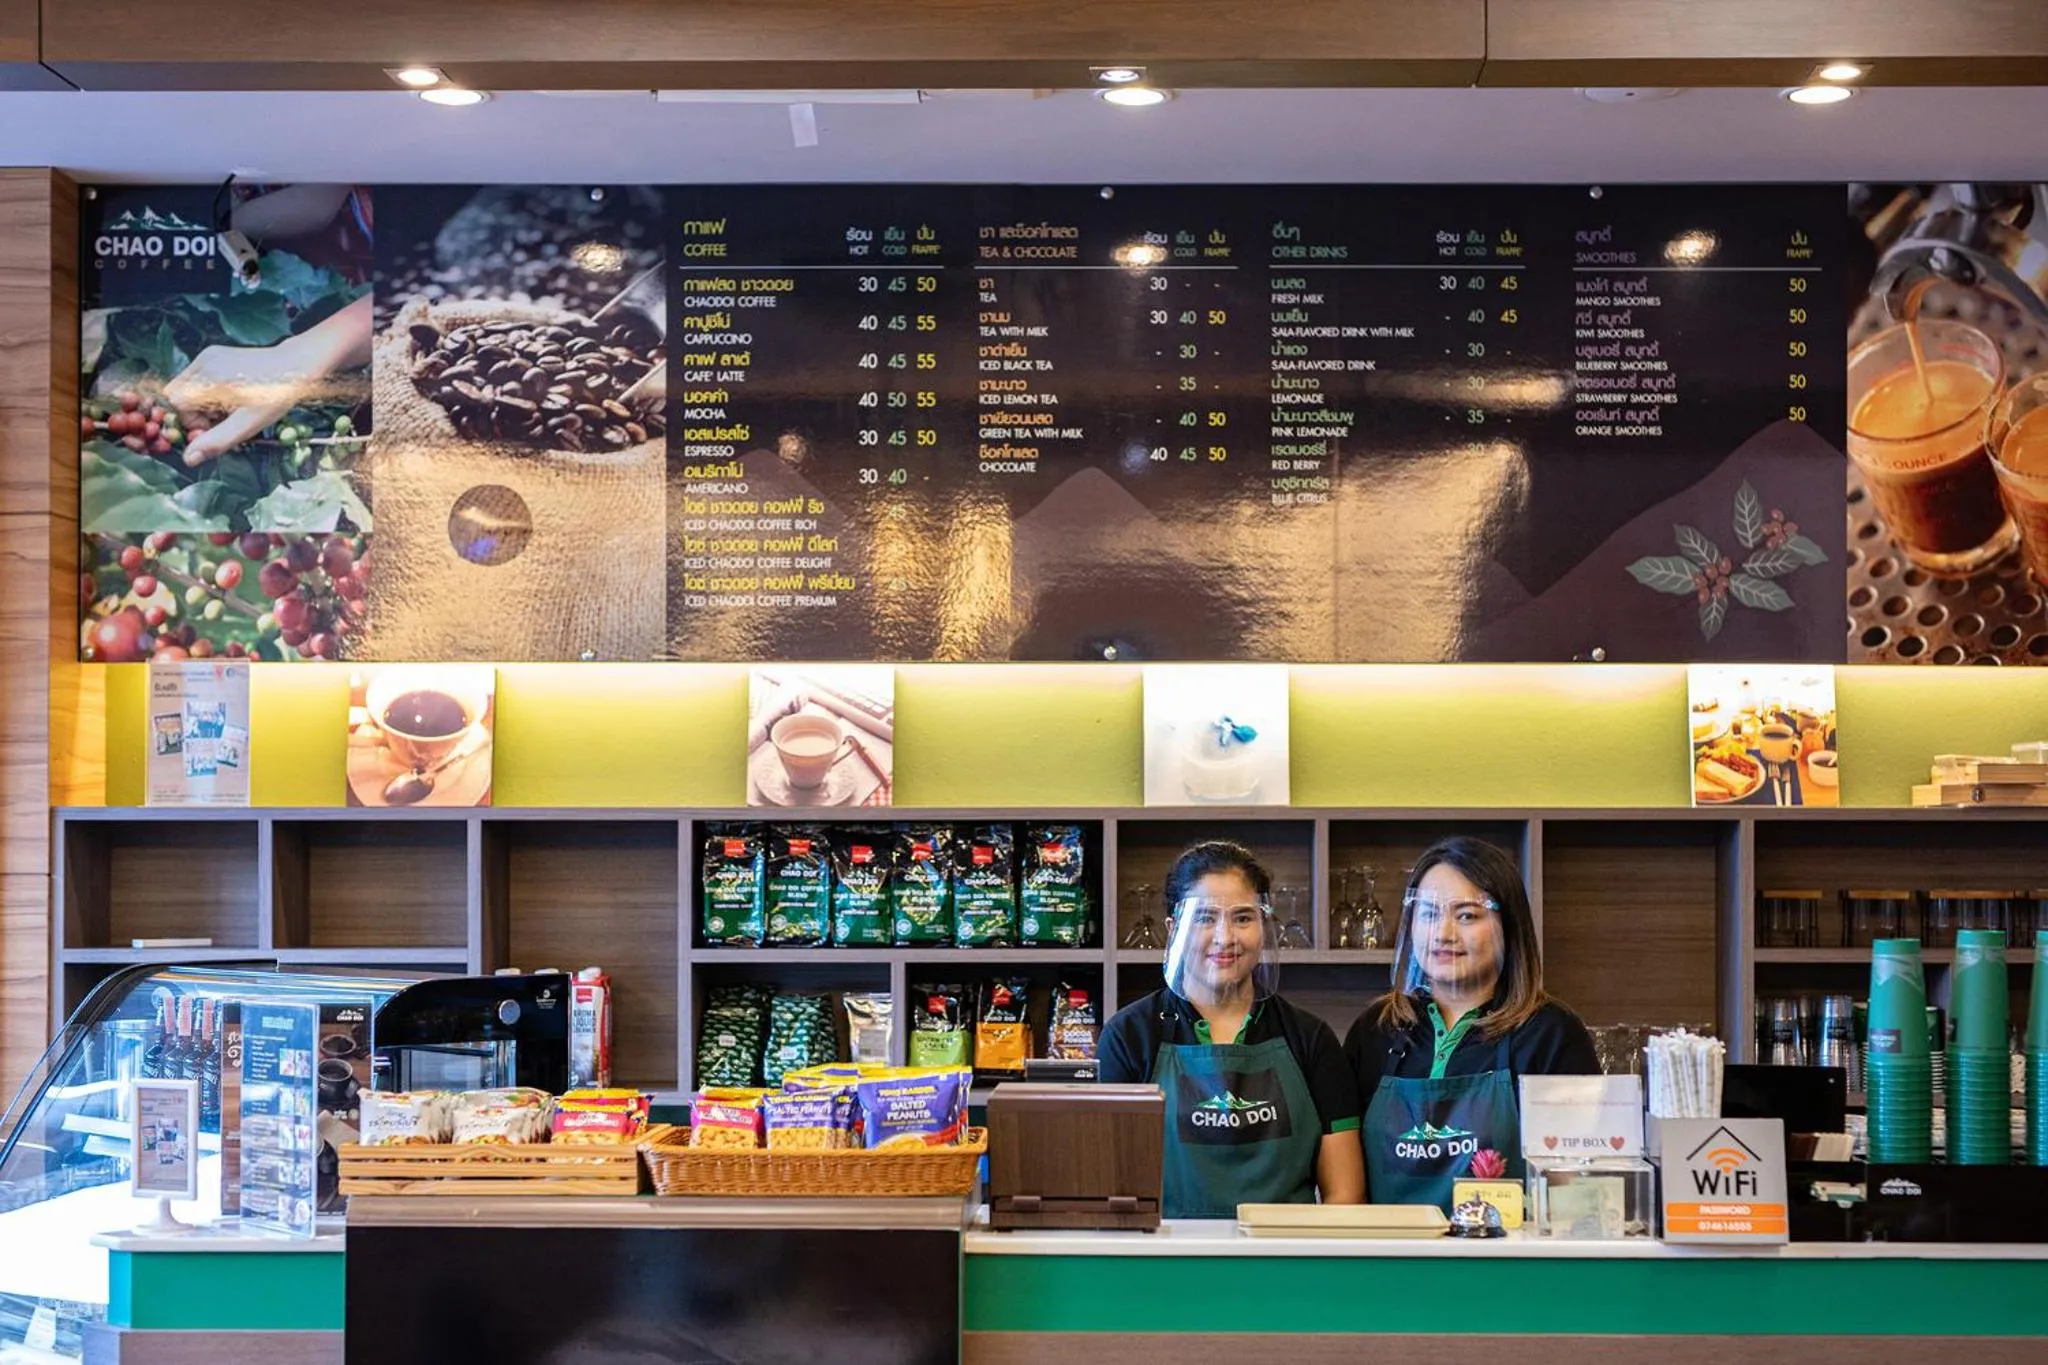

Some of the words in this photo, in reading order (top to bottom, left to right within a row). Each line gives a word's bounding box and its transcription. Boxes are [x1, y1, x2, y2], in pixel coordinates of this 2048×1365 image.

[684, 219, 727, 236] กาแฟ
[980, 227, 995, 239] ชา
[95, 236, 163, 256] CHAO
[173, 236, 215, 256] DOI
[684, 244, 727, 257] COFFEE
[849, 244, 869, 256] HOT
[882, 244, 907, 256] COLD
[979, 246, 998, 258] TEA
[1003, 246, 1011, 258] &
[1014, 246, 1078, 258] CHOCOLATE
[1272, 246, 1307, 258] OTHER
[1310, 246, 1348, 258] DRINKS
[1439, 246, 1457, 256] HOT
[1575, 251, 1637, 263] SMOOTHIES
[94, 258, 215, 270] COFFEE
[684, 277, 736, 291] กาแฟสด
[858, 276, 878, 292] 30
[888, 276, 907, 292] 45
[917, 276, 937, 292] 50
[979, 278, 995, 289] ชา
[1150, 276, 1168, 291] 30
[1439, 275, 1457, 290] 30
[1467, 275, 1485, 290] 40
[1501, 275, 1518, 290] 45
[1789, 277, 1806, 292] 50
[738, 296, 777, 307] COFFEE
[979, 292, 997, 303] TEA
[1271, 293, 1300, 304] FRESH
[1302, 293, 1324, 304] MILK
[1576, 295, 1611, 306] MANGO
[1613, 295, 1661, 306] SMOOTHIES
[979, 312, 1011, 323] ชานม
[1150, 310, 1168, 325] 30
[1179, 310, 1197, 325] 40
[1208, 310, 1226, 325] 50
[1467, 309, 1485, 324] 40
[1501, 309, 1518, 324] 45
[1789, 308, 1806, 324] 50
[858, 315, 878, 331] 40
[888, 315, 907, 331] 45
[917, 315, 937, 331] 55
[979, 327, 997, 337] TEA
[1000, 327, 1024, 337] WITH
[1027, 327, 1049, 337] MILK
[1341, 327, 1368, 338] DRINK
[1370, 327, 1393, 338] WITH
[1394, 327, 1415, 338] MILK
[1576, 328, 1595, 338] KIWI
[1597, 328, 1645, 338] SMOOTHIES
[684, 333, 752, 344] CAPPUCCINO
[1179, 344, 1197, 359] 30
[1467, 343, 1485, 358] 30
[1789, 341, 1806, 356] 50
[858, 353, 878, 369] 40
[888, 353, 907, 369] 45
[917, 353, 937, 369] 55
[979, 360, 1000, 371] ICED
[1003, 360, 1033, 371] BLACK
[1036, 360, 1054, 371] TEA
[1347, 360, 1376, 371] DRINK
[1575, 361, 1617, 371] BLUEBERRY
[1619, 361, 1668, 371] SMOOTHIES
[717, 371, 745, 382] LATTE
[1789, 373, 1806, 388] 50
[979, 380, 1027, 391] ชามะนาว
[1179, 376, 1197, 391] 35
[1467, 376, 1485, 391] 30
[858, 392, 878, 408] 40
[888, 392, 907, 408] 50
[917, 392, 937, 408] 55
[979, 394, 1000, 405] ICED
[1003, 394, 1037, 405] LEMON
[1041, 394, 1058, 405] TEA
[1271, 394, 1324, 404] LEMONADE
[1575, 393, 1628, 403] STRAWBERRY
[1630, 393, 1678, 403] SMOOTHIES
[684, 408, 726, 419] MOCHA
[1179, 412, 1197, 427] 40
[1208, 412, 1226, 427] 50
[1467, 410, 1485, 425] 35
[1789, 406, 1806, 421] 50
[979, 428, 1011, 439] GREEN
[1014, 428, 1032, 439] TEA
[1034, 428, 1059, 439] WITH
[1061, 428, 1083, 439] MILK
[1271, 427, 1294, 437] PINK
[1297, 427, 1349, 437] LEMONADE
[1575, 426, 1612, 436] ORANGE
[1614, 426, 1662, 436] SMOOTHIES
[858, 430, 878, 446] 30
[888, 430, 907, 446] 45
[917, 430, 937, 446] 50
[684, 445, 734, 457] ESPRESSO
[1150, 447, 1168, 462] 40
[1179, 447, 1197, 462] 45
[1208, 447, 1226, 462] 50
[979, 462, 1037, 473] CHOCOLATE
[1271, 460, 1290, 470] RED
[1293, 460, 1320, 470] BERRY
[858, 468, 878, 484] 30
[888, 468, 907, 484] 40
[684, 482, 749, 494] AMERICANO
[757, 519, 792, 530] COFFEE
[795, 519, 817, 530] RICH
[757, 557, 792, 568] COFFEE
[795, 557, 832, 568] DELIGHT
[757, 595, 792, 607] COFFEE
[795, 595, 837, 607] PREMIUM
[890, 1101, 927, 1111] SALTED
[887, 1110, 932, 1120] PEANUTS
[1191, 1110, 1241, 1128] CHAO
[1247, 1106, 1277, 1125] DOI
[1562, 1137, 1580, 1147] TIP
[1582, 1137, 1607, 1147] BOX
[1395, 1142, 1441, 1159] CHAO
[1448, 1138, 1478, 1156] DOI
[1692, 1168, 1758, 1197] WiFi
[1880, 1186, 1904, 1195] CHAO
[1906, 1186, 1922, 1195] DOI
